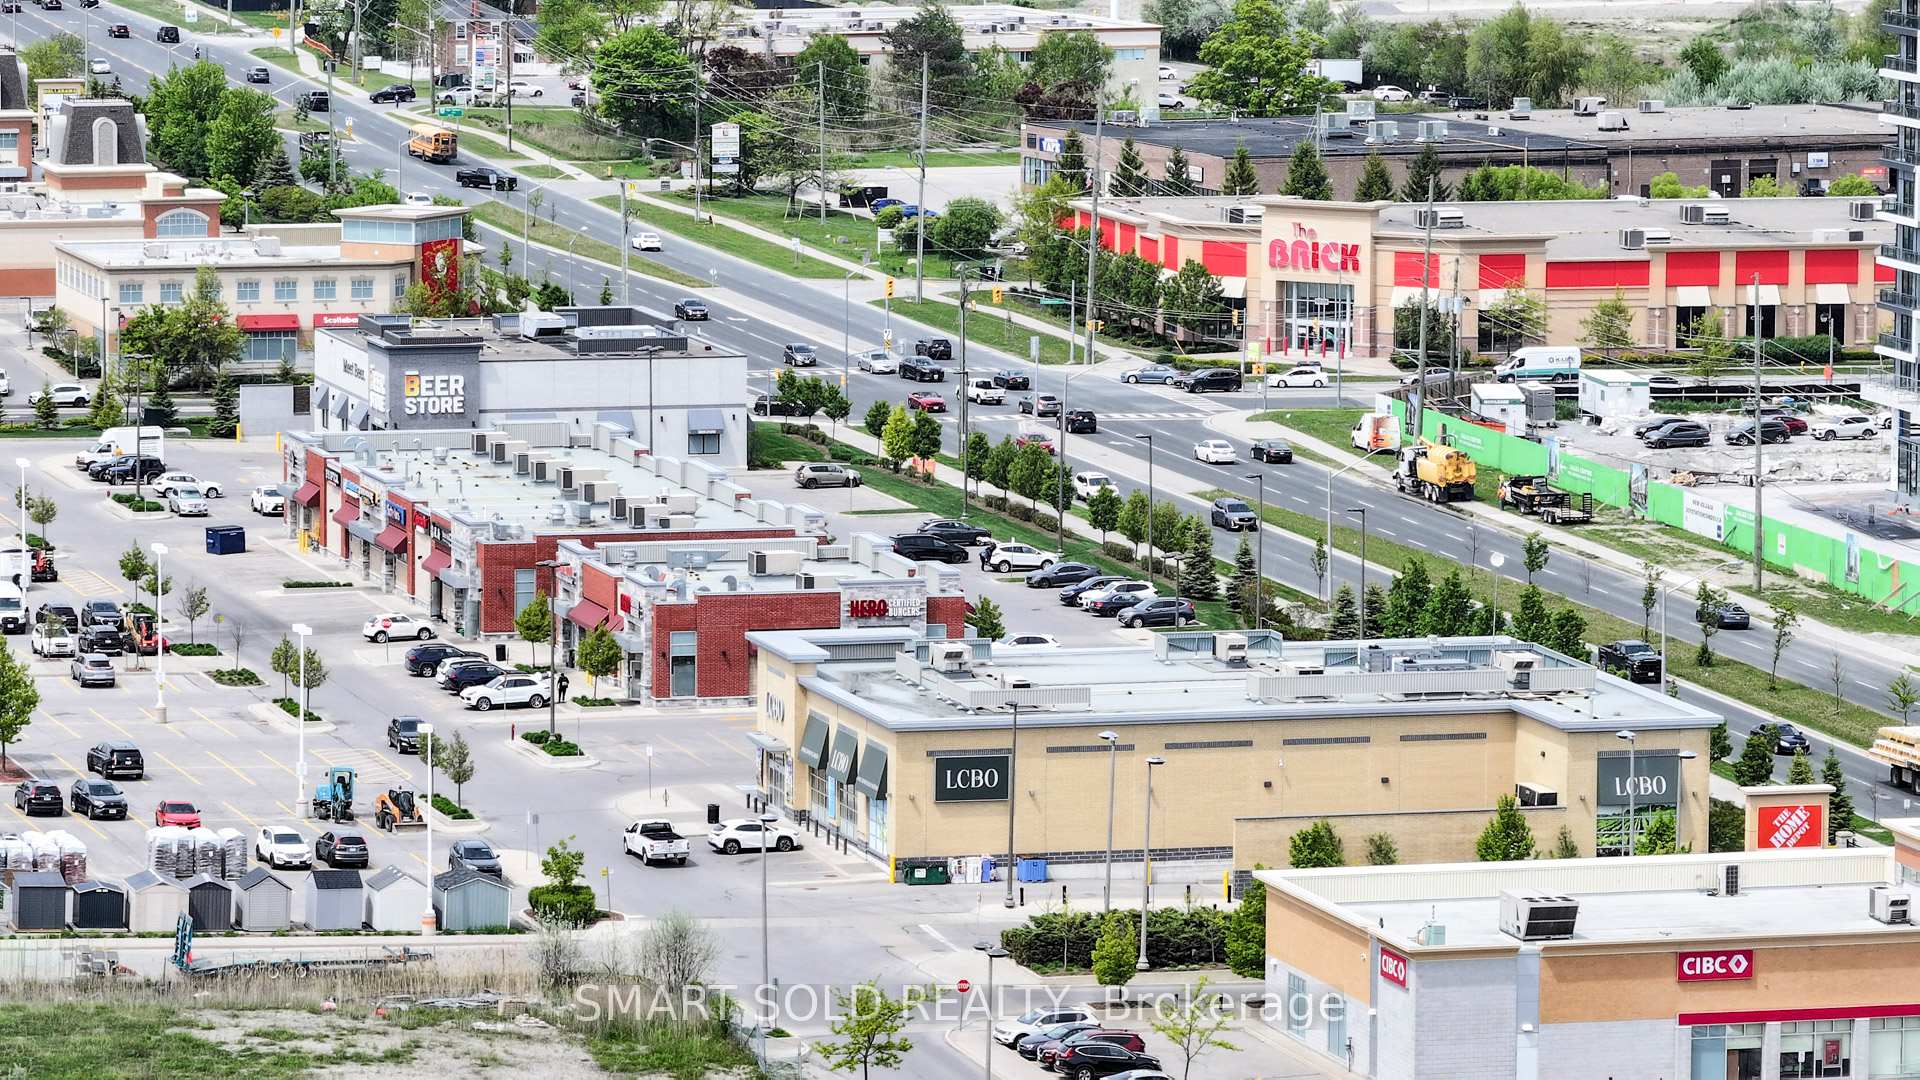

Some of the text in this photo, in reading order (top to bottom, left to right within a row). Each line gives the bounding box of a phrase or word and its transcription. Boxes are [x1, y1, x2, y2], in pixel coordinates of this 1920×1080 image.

[1292, 222, 1317, 240] The
[1269, 239, 1360, 271] BRICK
[405, 371, 464, 397] BEER
[405, 397, 464, 414] STORE
[850, 599, 887, 617] HERO
[888, 599, 920, 608] CERTIFIED
[888, 607, 920, 617] BURGERS
[831, 749, 849, 774] LCBO
[946, 768, 999, 789] LCBO
[1615, 775, 1667, 796] LCBO
[1769, 806, 1810, 849] HOME
[1772, 808, 1792, 828] THE
[1786, 821, 1810, 848] DEPOT
[1382, 955, 1398, 977] CIBC
[1682, 955, 1728, 975] CIBC
